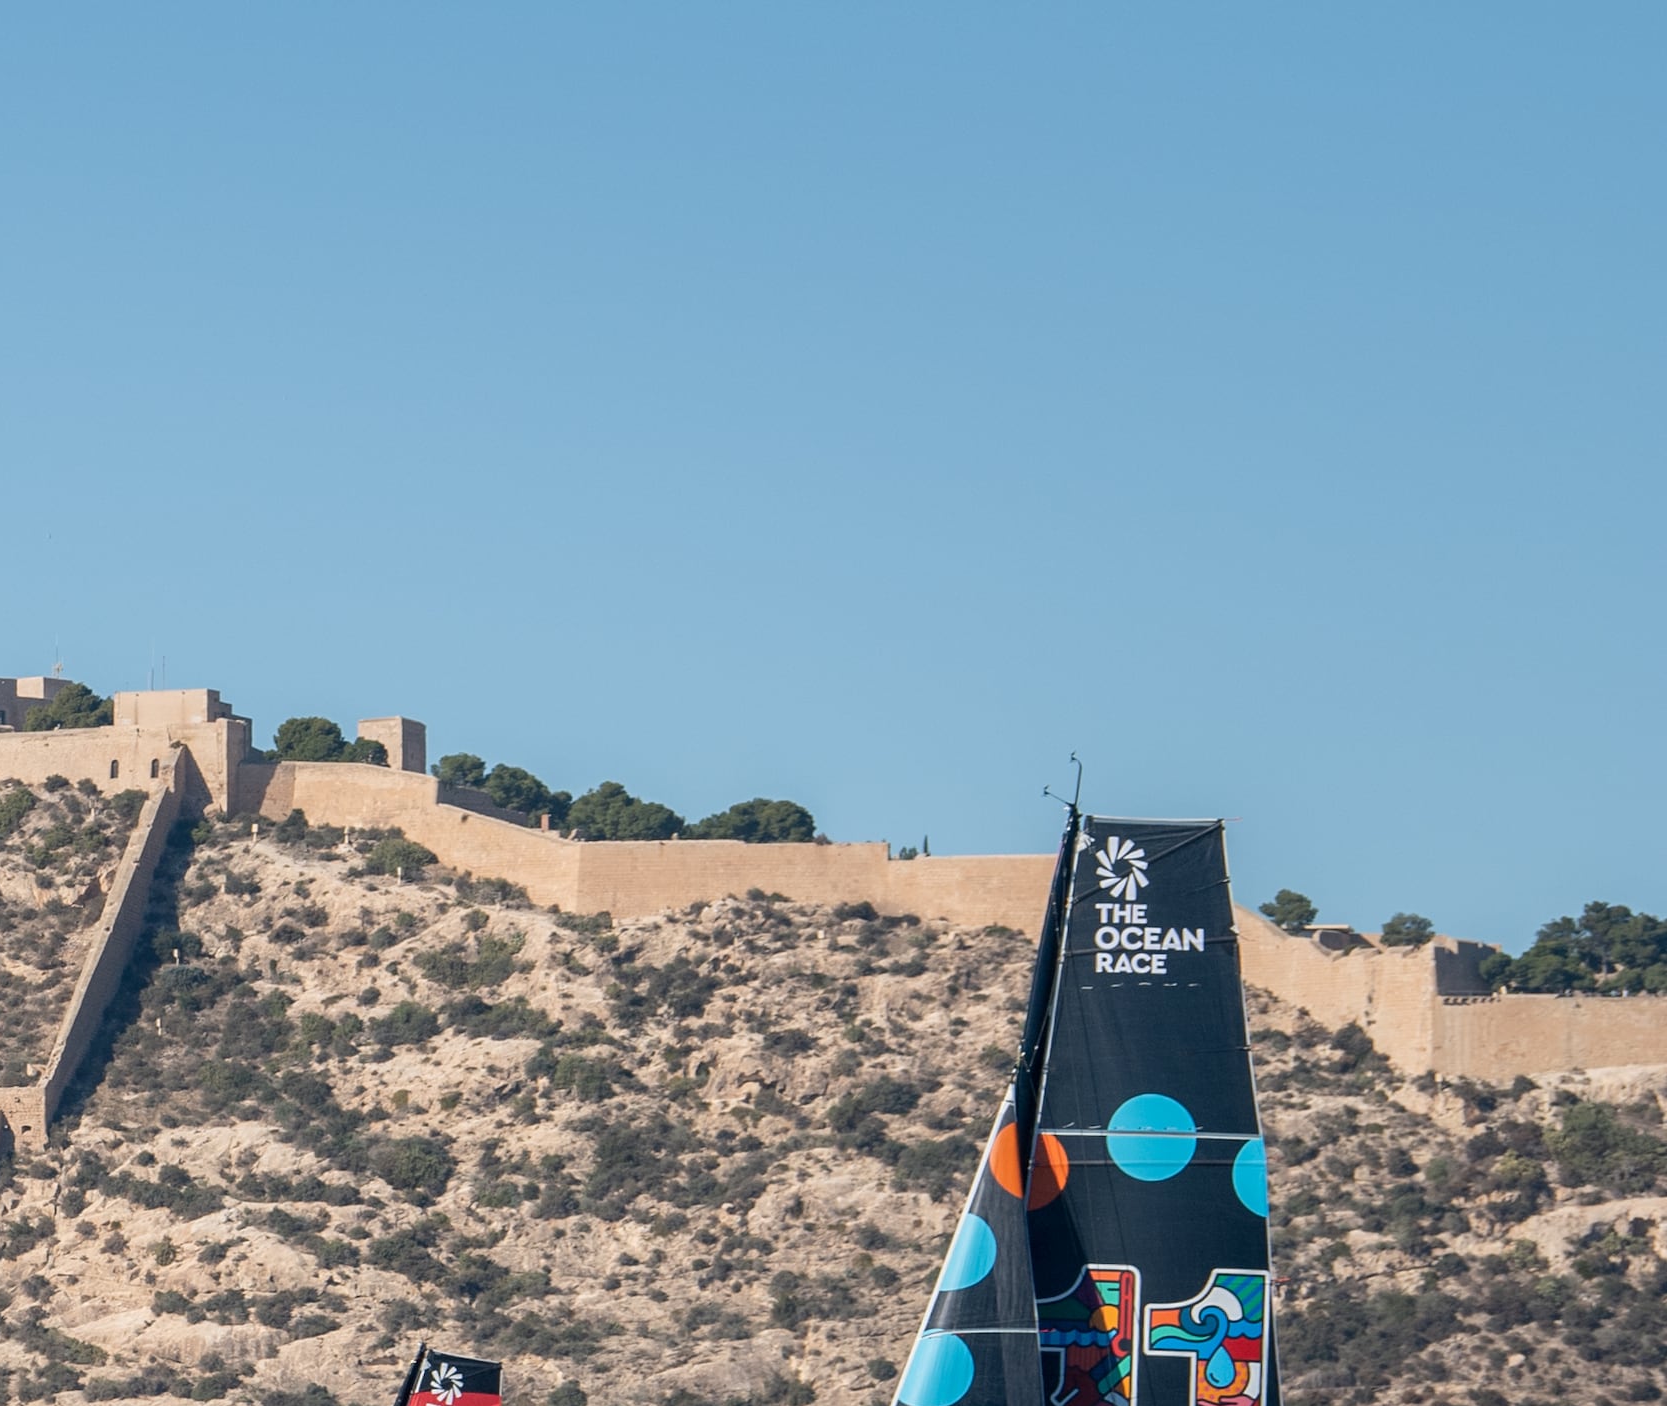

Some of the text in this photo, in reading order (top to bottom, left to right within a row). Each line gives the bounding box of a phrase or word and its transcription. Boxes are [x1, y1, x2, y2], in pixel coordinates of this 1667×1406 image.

[1095, 903, 1148, 924] THE
[1094, 926, 1205, 952] OCEAN
[1095, 952, 1167, 974] RACE
